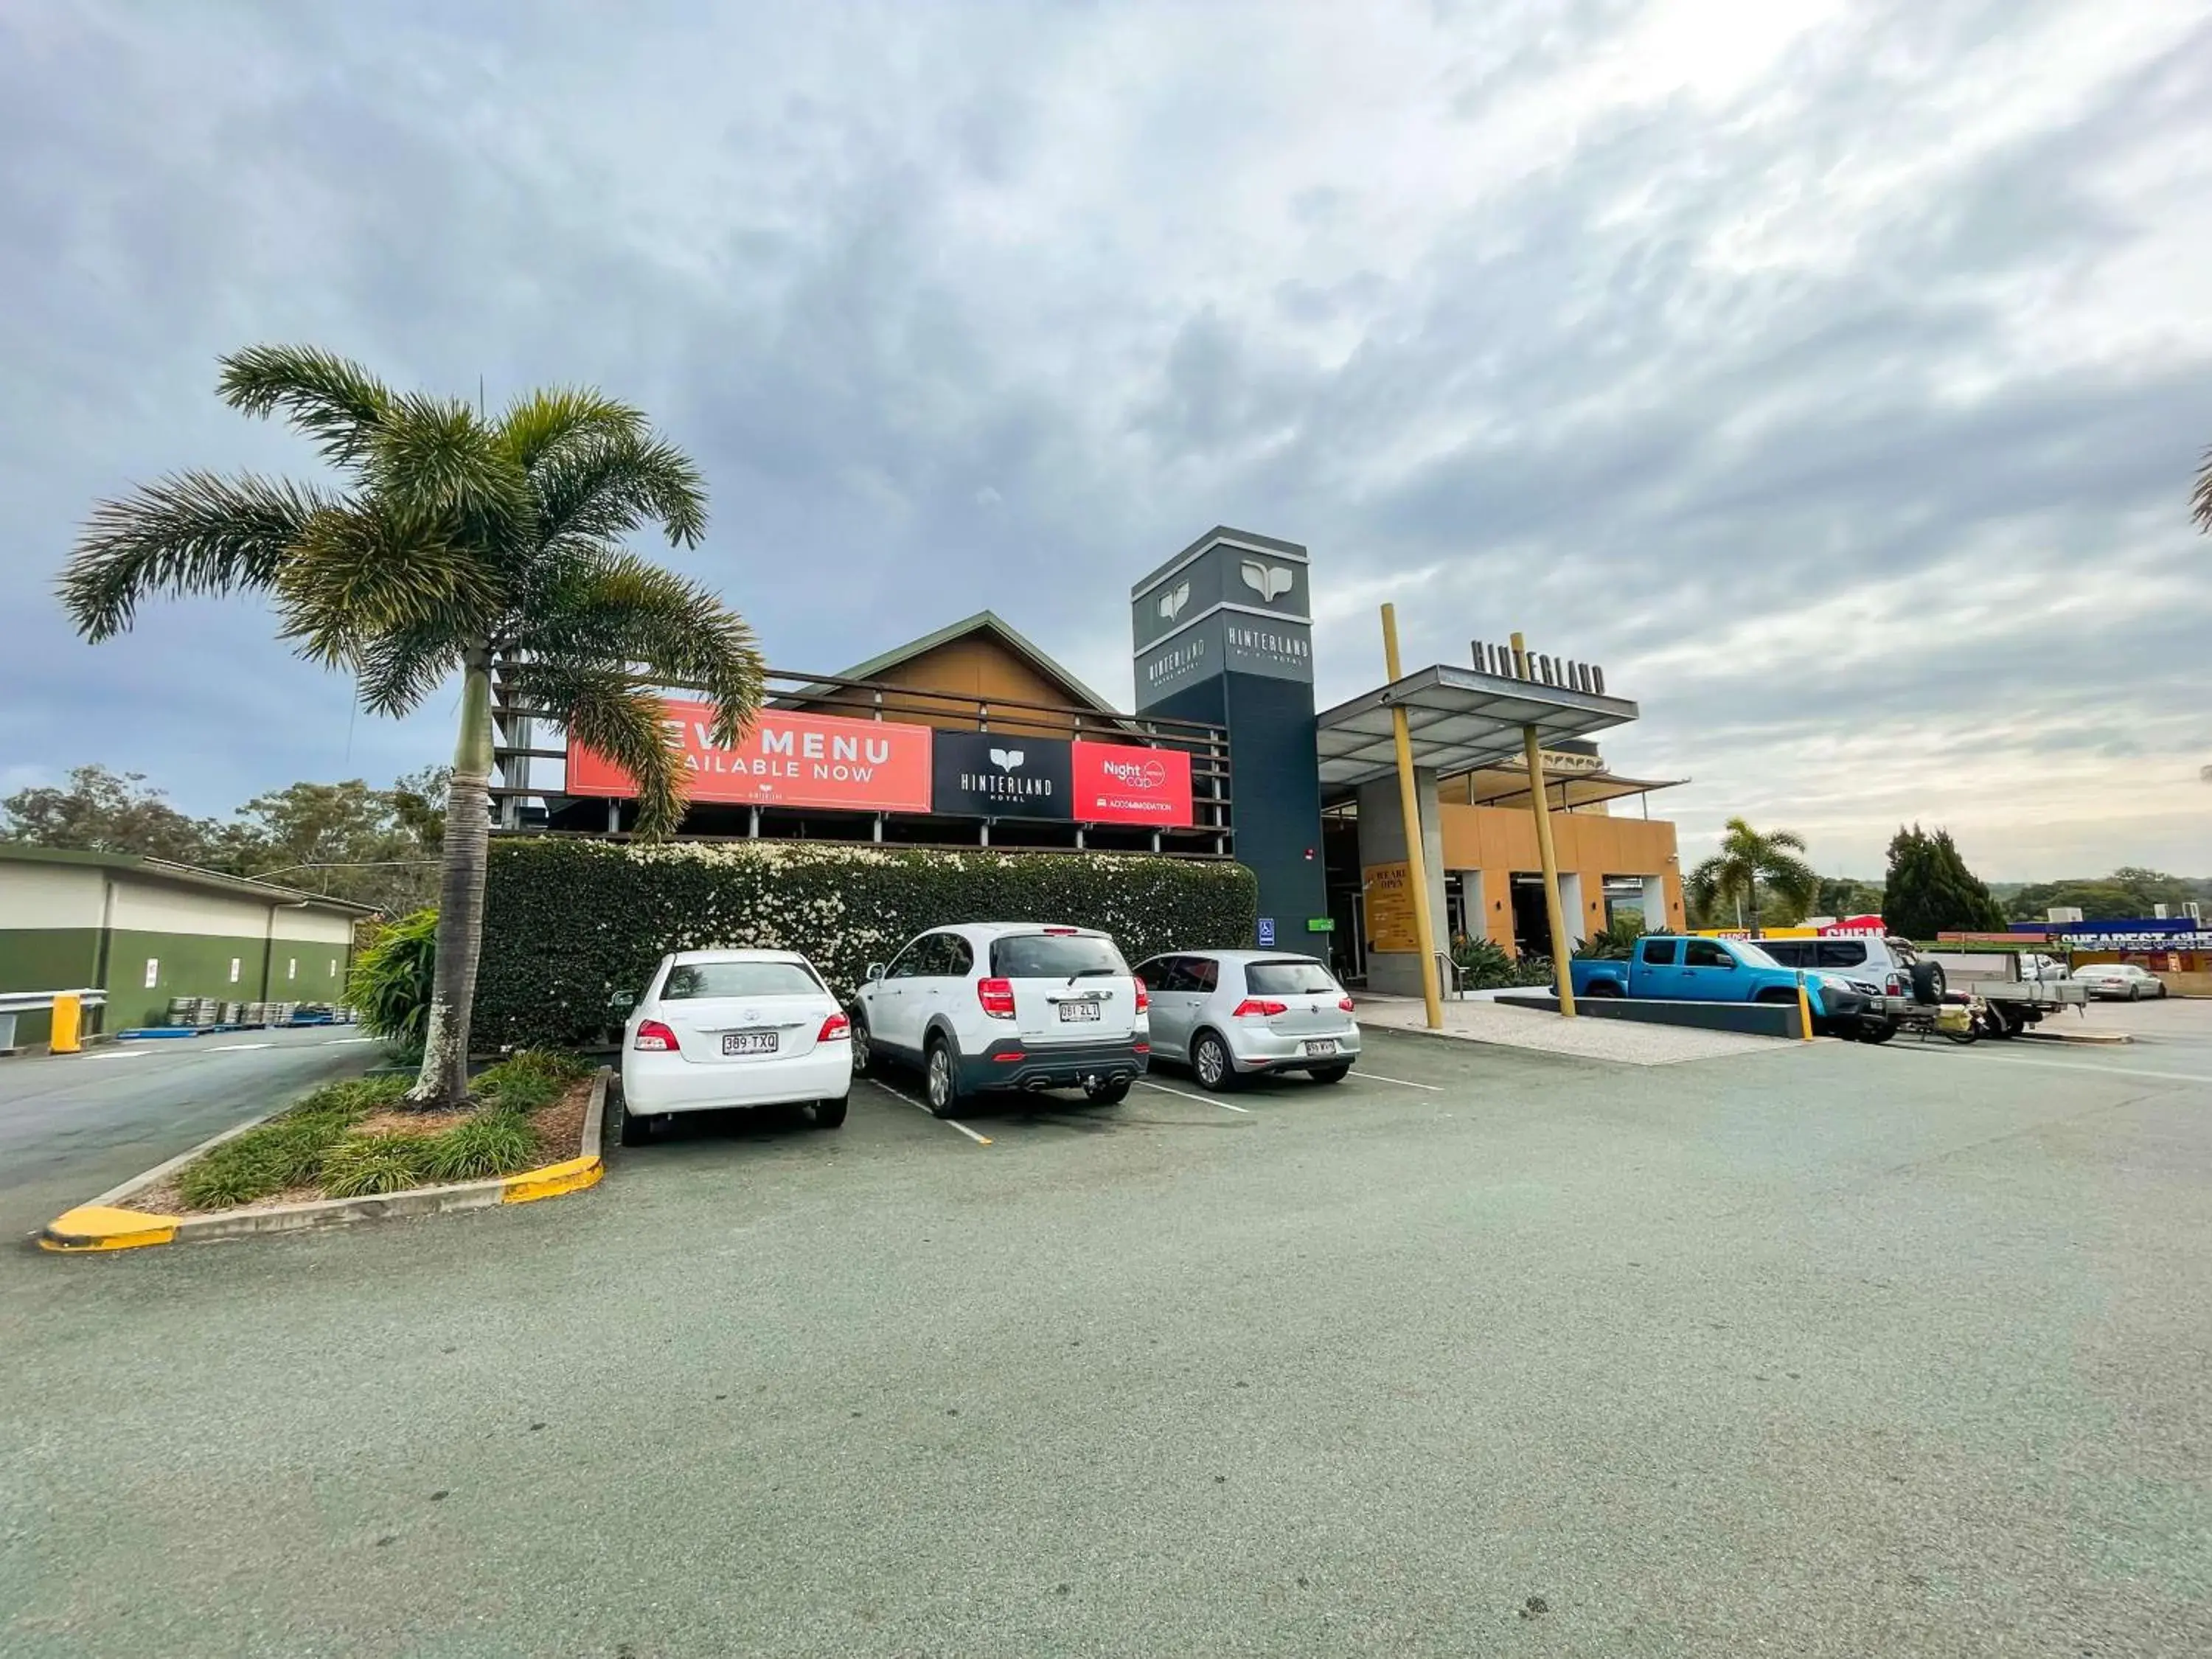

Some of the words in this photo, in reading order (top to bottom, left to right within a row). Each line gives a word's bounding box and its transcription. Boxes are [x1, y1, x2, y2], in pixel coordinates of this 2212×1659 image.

[1228, 627, 1309, 658] HINTERLAND
[1471, 639, 1605, 695] HINERLAND
[762, 728, 889, 765] MENU
[813, 762, 873, 783] NOW
[1103, 759, 1141, 781] Night
[961, 773, 1053, 796] HINTERLAND
[726, 1037, 747, 1049] 389
